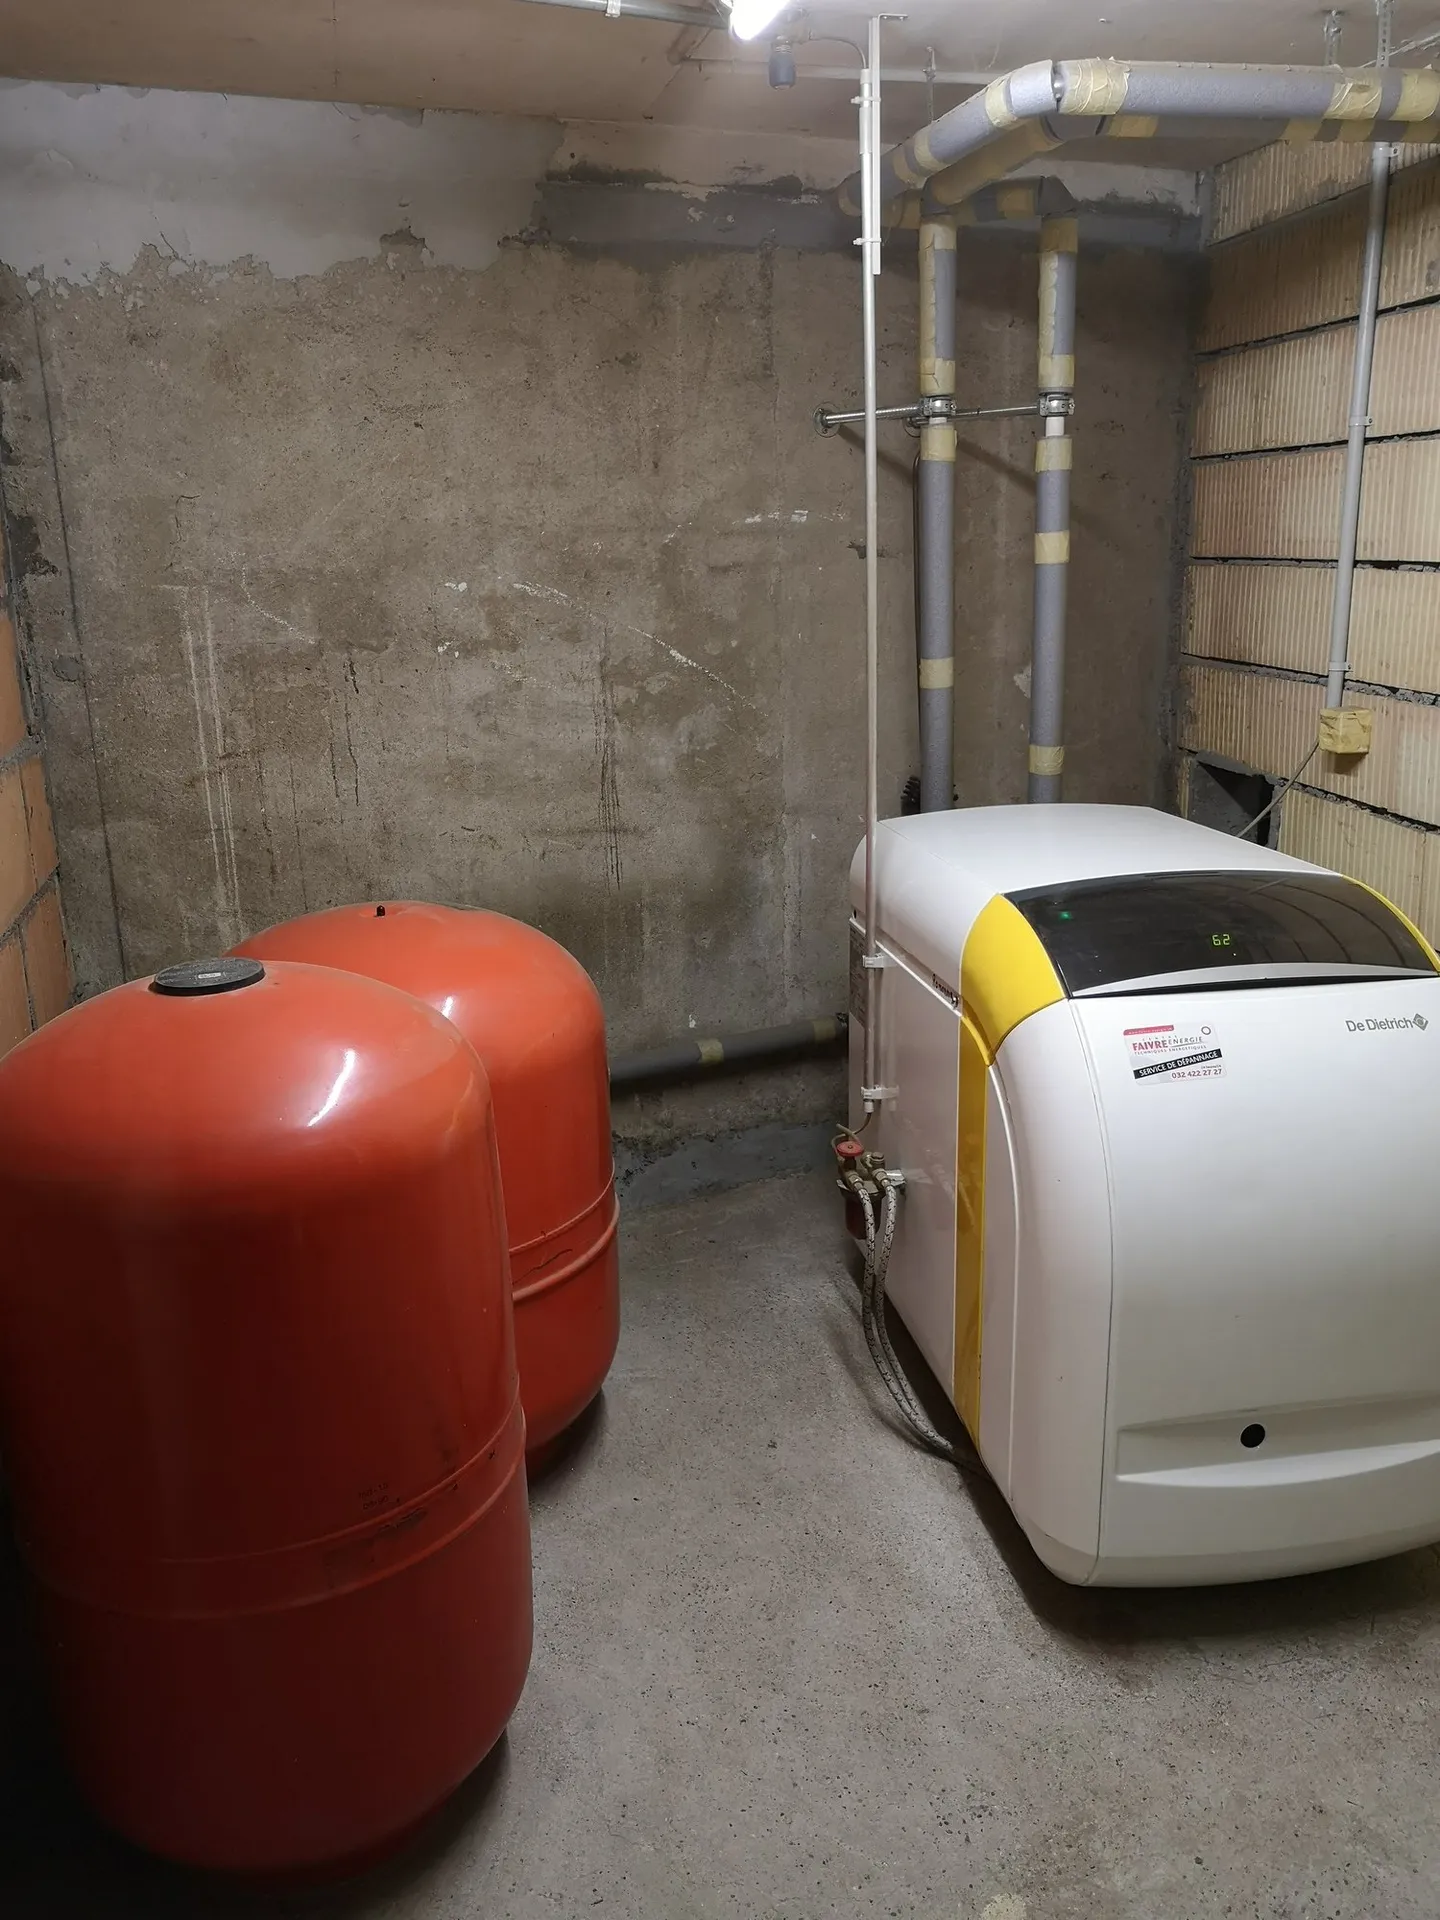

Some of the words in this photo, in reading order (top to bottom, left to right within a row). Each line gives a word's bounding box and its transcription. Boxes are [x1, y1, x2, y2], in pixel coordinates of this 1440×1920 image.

[1212, 933, 1230, 946] 62
[1345, 1020, 1365, 1032] De
[1366, 1017, 1413, 1031] Dietrich
[1139, 1065, 1167, 1077] SERVICE
[1167, 1062, 1176, 1071] DE
[1177, 1050, 1218, 1067] DÉPANNAGE
[1171, 1071, 1186, 1079] 032
[1187, 1070, 1201, 1078] 422
